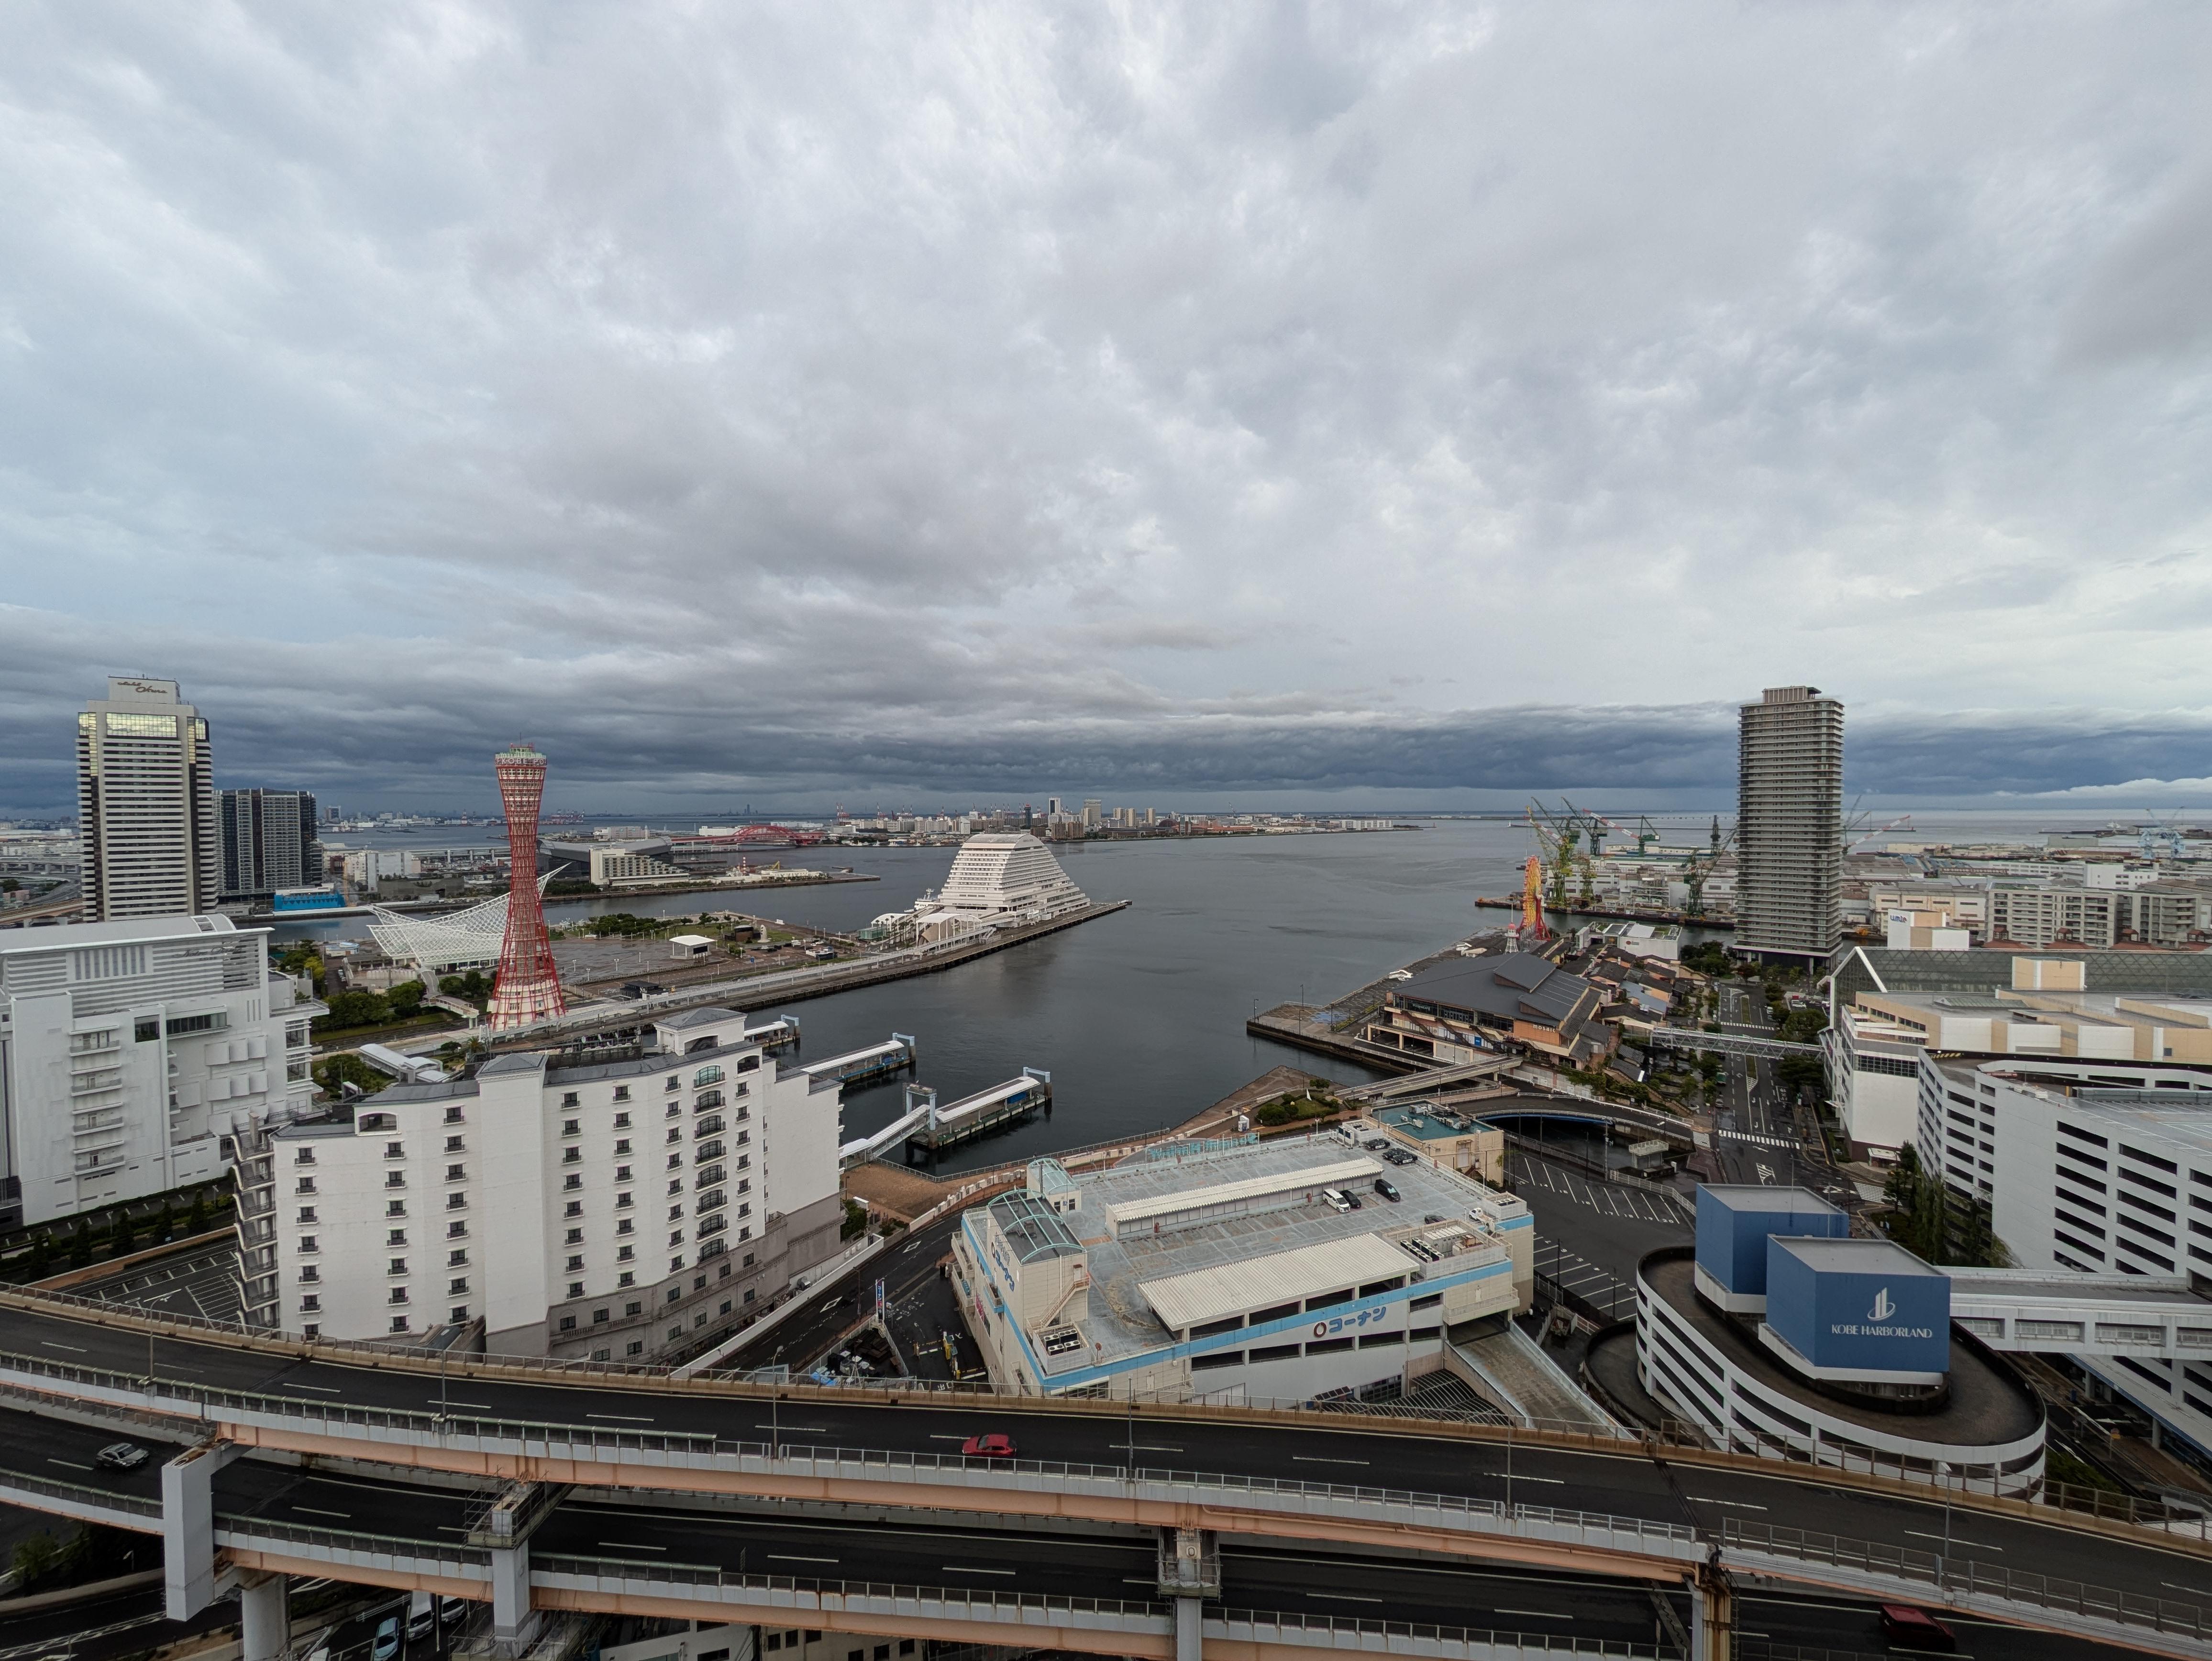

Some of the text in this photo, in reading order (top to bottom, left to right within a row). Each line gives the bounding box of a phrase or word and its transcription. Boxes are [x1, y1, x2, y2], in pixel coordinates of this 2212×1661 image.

[135, 686, 167, 694] Okura
[1329, 1306, 1382, 1333] コーナン
[1832, 1324, 1933, 1338] KOBE HARBORLAND
